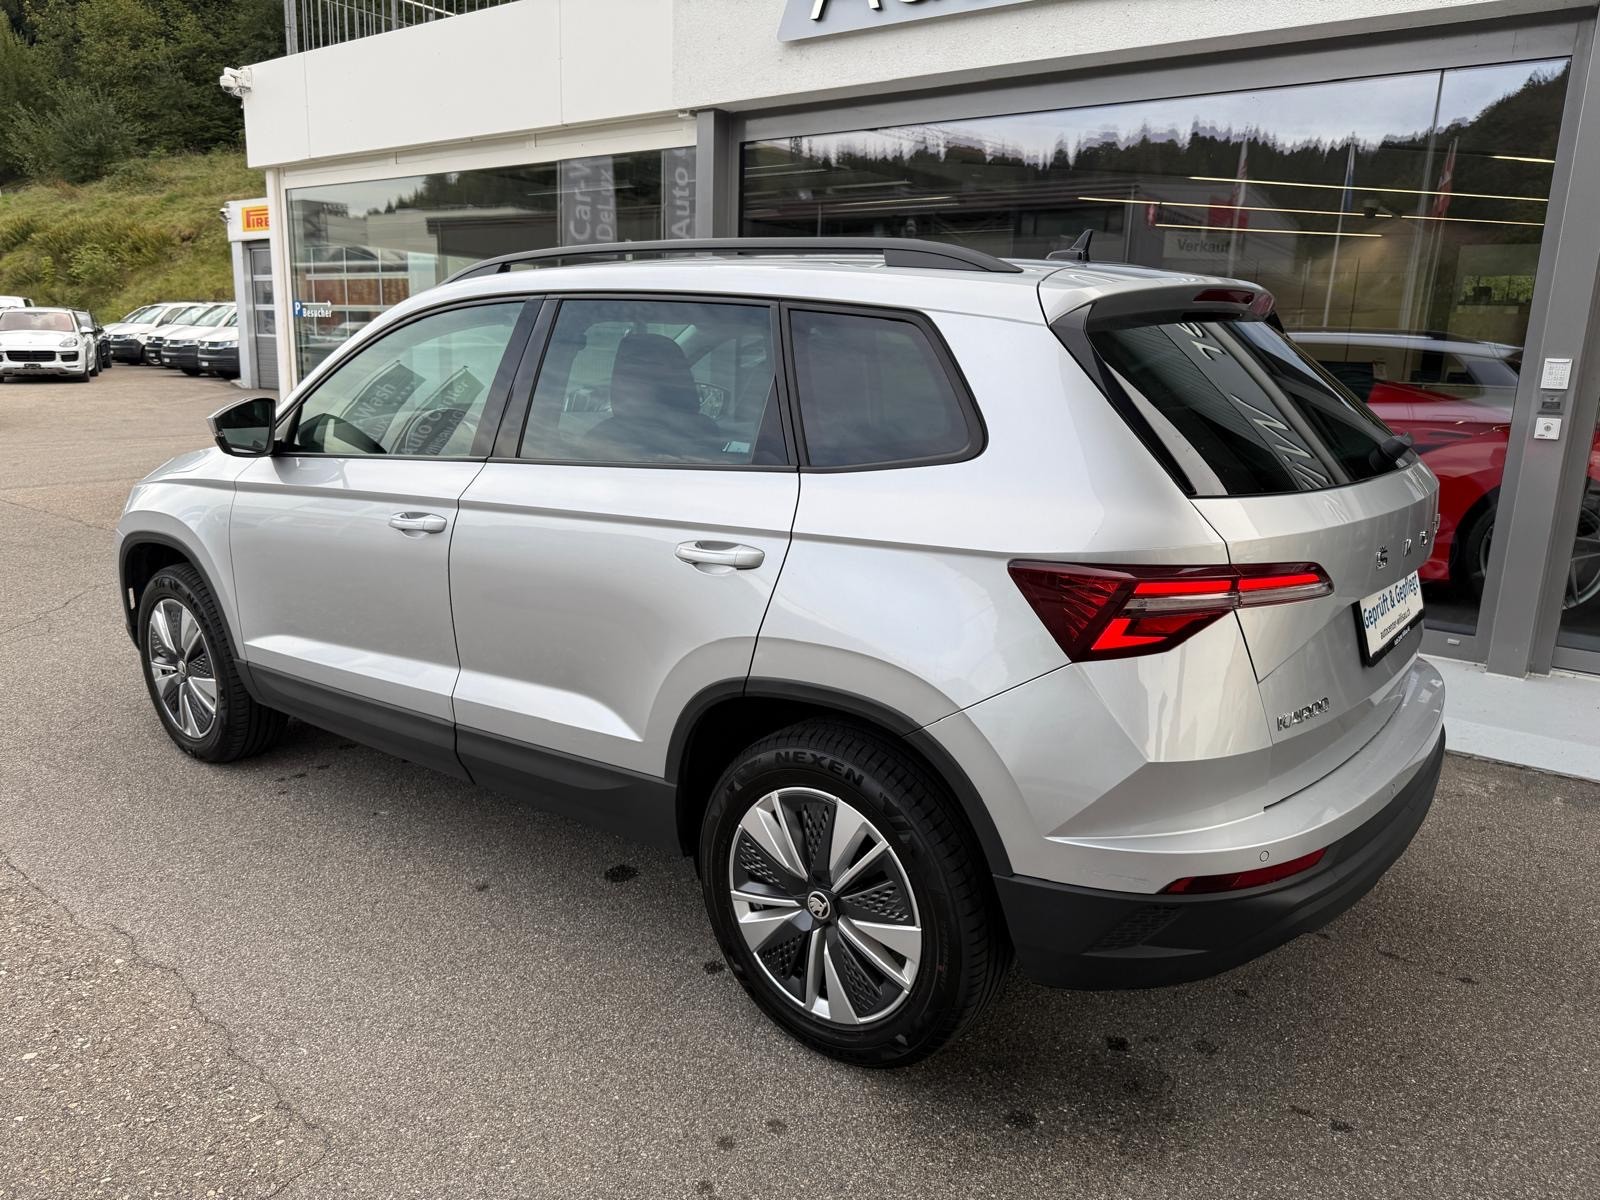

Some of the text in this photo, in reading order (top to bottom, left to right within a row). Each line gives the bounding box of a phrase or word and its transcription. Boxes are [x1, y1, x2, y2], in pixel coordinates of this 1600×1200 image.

[672, 167, 691, 239] Auto
[1177, 238, 1231, 254] Verkauf
[294, 301, 301, 316] P
[302, 307, 332, 318] Besucher
[1363, 574, 1419, 630] Geprüft & Gepflegt
[774, 750, 865, 787] NEXEN
